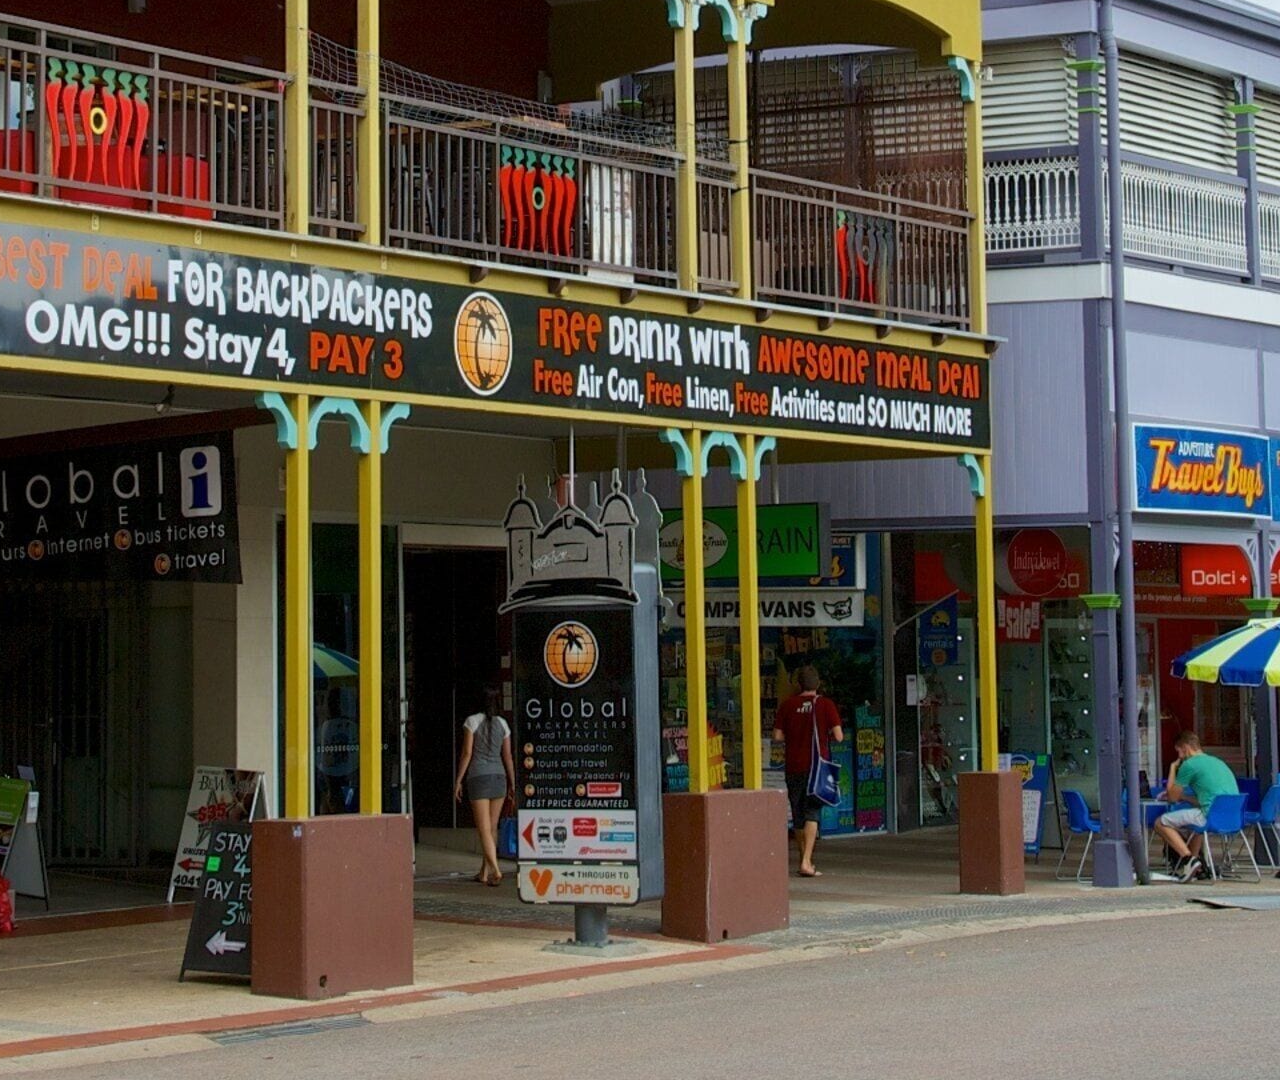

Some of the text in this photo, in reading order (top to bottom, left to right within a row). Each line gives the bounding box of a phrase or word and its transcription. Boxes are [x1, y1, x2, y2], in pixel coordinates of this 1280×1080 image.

[167, 259, 226, 316] FOR
[25, 299, 404, 380] OMG!!! Stay 4, PAY 3
[533, 358, 972, 436] Free Air Con, Free Linen, Free Activities and SO MUCH MORE
[1178, 440, 1215, 457] ADVENTURE
[47, 531, 110, 556] internet
[134, 526, 162, 546] bus
[166, 520, 226, 542] tickets
[174, 548, 226, 570] travel
[1191, 570, 1236, 586] Dolci
[923, 638, 954, 649] rentals
[526, 697, 626, 718] Global
[527, 720, 626, 730] BACKPACKERS
[540, 731, 555, 739] and
[535, 743, 613, 752] accommodation
[536, 759, 607, 768] tours and travel
[584, 771, 614, 779] Zealand
[537, 785, 573, 794] internet
[526, 799, 629, 808] BEST PRICE GUARANTEED
[577, 871, 629, 880] THROUGH TO
[204, 878, 233, 902] PAY
[556, 881, 631, 899] pharmacy
